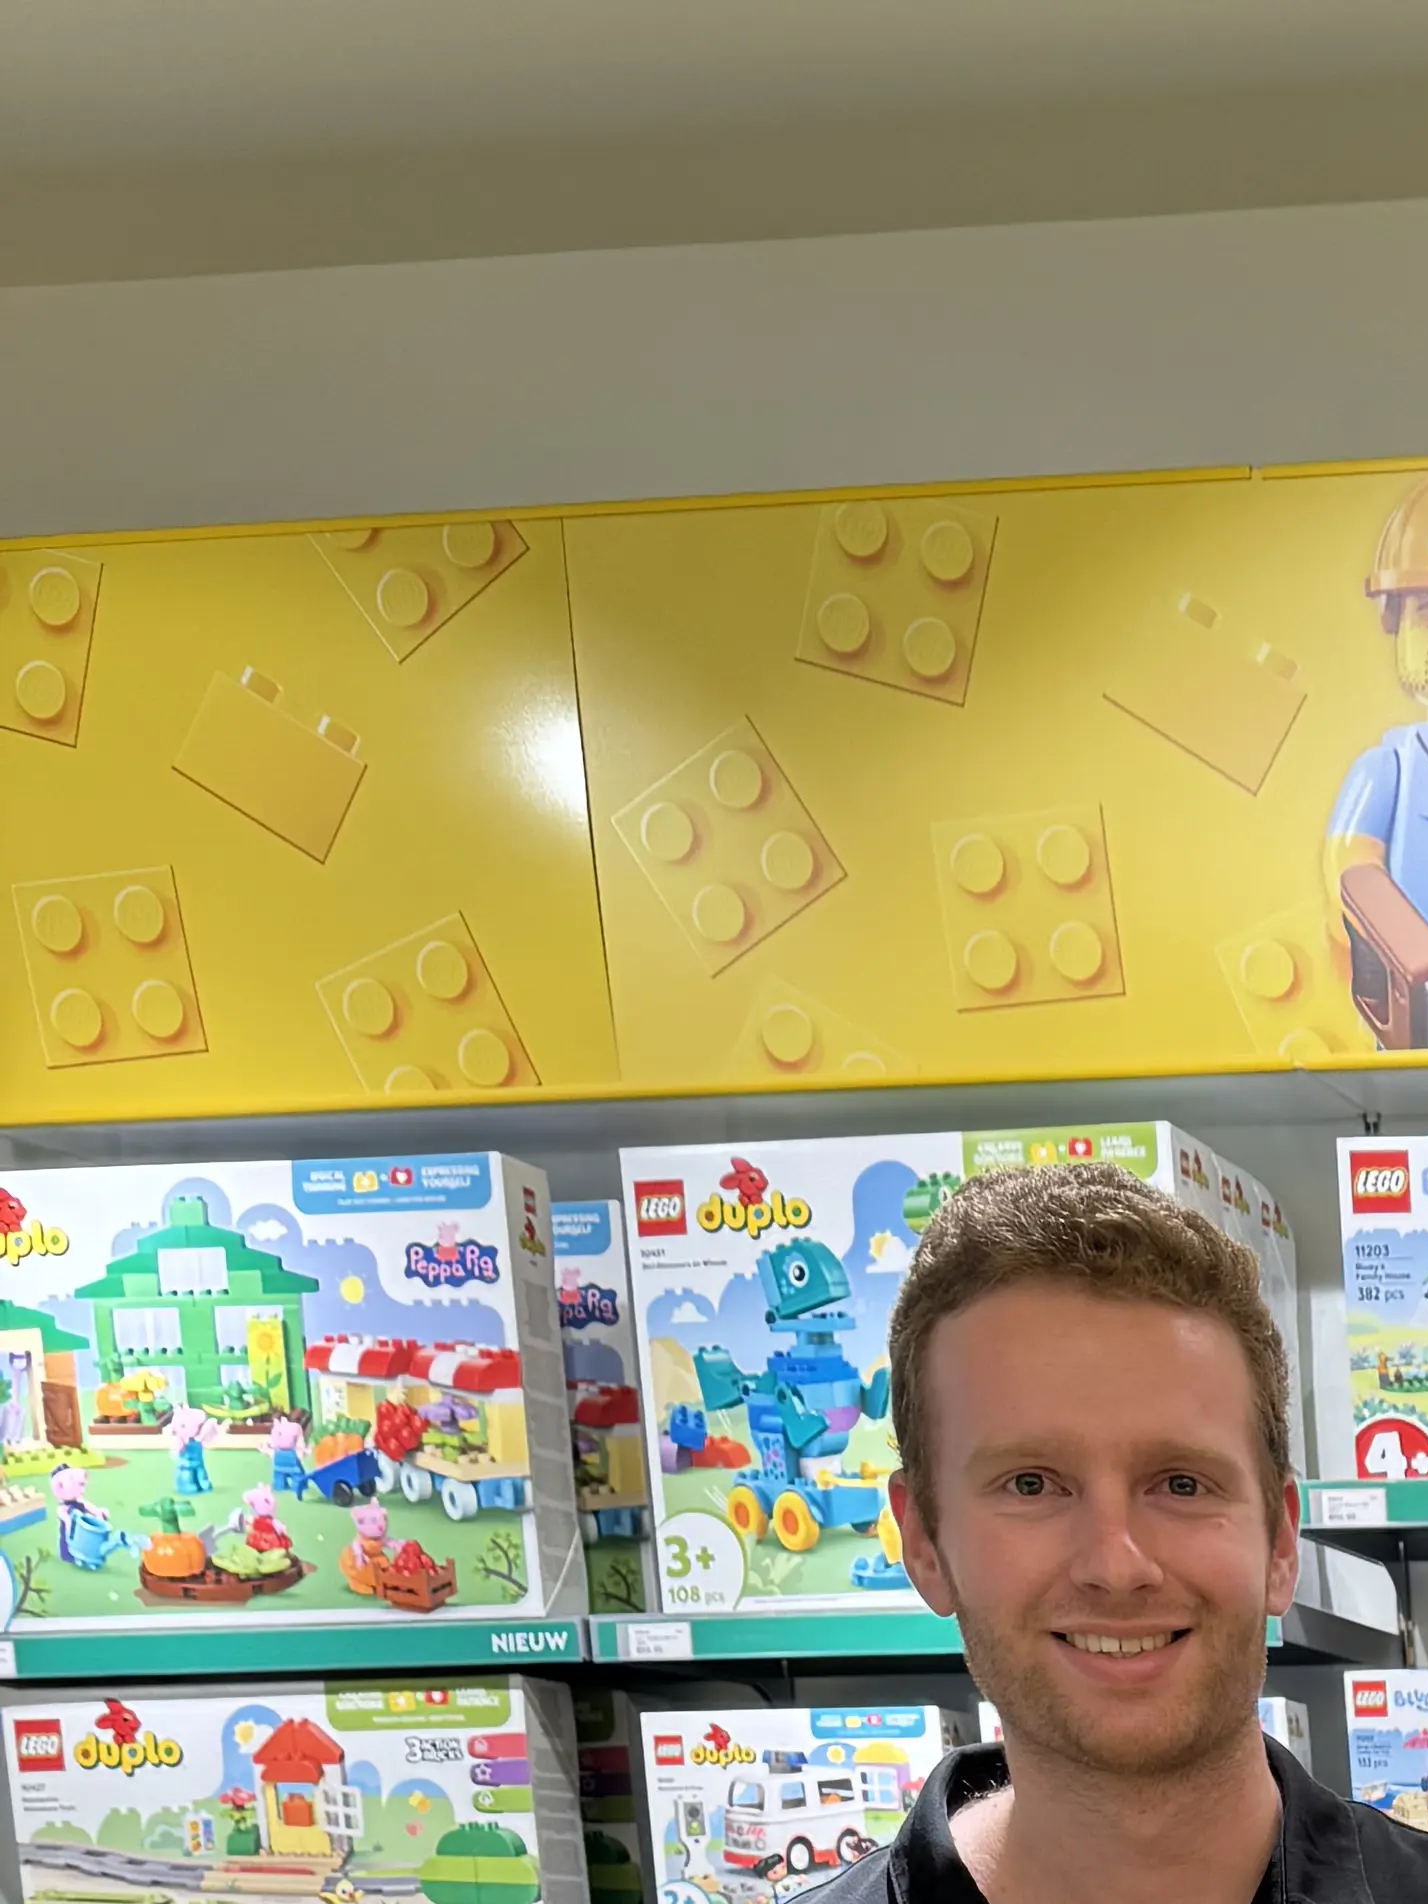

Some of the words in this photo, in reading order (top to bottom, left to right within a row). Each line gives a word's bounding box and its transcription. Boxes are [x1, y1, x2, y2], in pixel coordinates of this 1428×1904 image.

[1357, 1169, 1406, 1195] LEGO
[640, 1196, 682, 1219] LEGO
[696, 1189, 812, 1239] duplo
[410, 1246, 465, 1283] Peppa
[465, 1243, 495, 1281] Pig
[1355, 1244, 1390, 1258] 11203
[1357, 1286, 1381, 1302] 382
[663, 1535, 716, 1578] 3+
[668, 1585, 701, 1605] 108
[491, 1630, 569, 1654] NIEUW
[73, 1730, 183, 1777] duplo
[405, 1736, 422, 1763] 3
[689, 1743, 756, 1769] duplo
